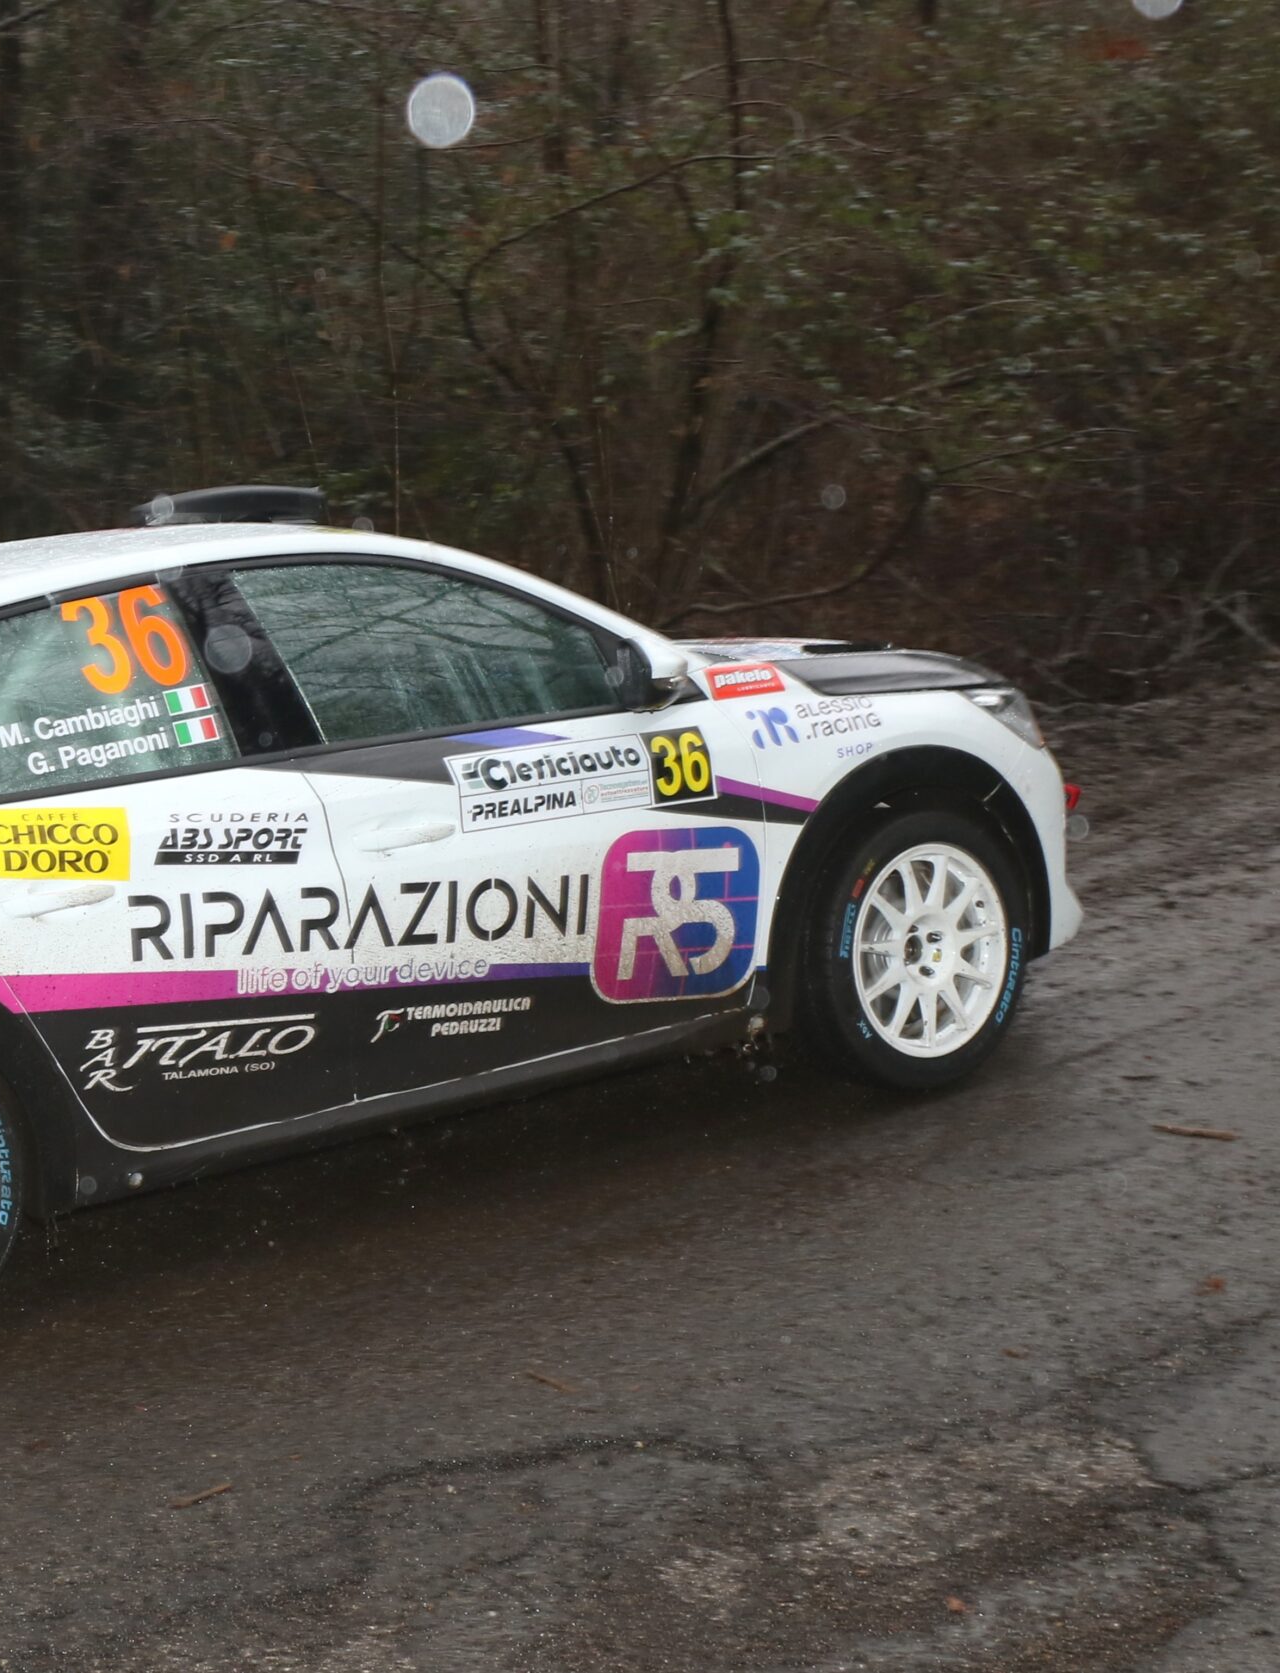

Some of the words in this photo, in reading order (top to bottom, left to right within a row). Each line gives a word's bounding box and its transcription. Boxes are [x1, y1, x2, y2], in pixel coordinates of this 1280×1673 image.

[61, 584, 187, 694] 36
[713, 668, 772, 688] pakelo
[33, 696, 161, 740] Cambiaghi
[27, 751, 56, 775] G.
[58, 727, 170, 769] Paganoni
[836, 742, 873, 758] SHOP
[650, 732, 710, 797] 36
[169, 812, 309, 823] SCUDERIA
[472, 790, 577, 822] PREALPINA
[158, 828, 213, 850] ABS
[217, 827, 309, 850] SPORT
[3, 849, 110, 873] D'ORO
[184, 853, 220, 863] SSD
[229, 853, 242, 863] A
[253, 853, 273, 863] RL
[128, 873, 589, 962] RIPARAZIONI
[237, 966, 288, 994] life
[290, 961, 325, 990] of
[325, 966, 392, 994] your
[396, 957, 490, 984] device
[406, 997, 531, 1021] TERMOIDRAULICA
[431, 1017, 502, 1037] PEDRUZZI
[80, 1029, 134, 1092] BAR
[122, 1025, 316, 1070] ITALO
[162, 1065, 239, 1081] TALAMONA
[244, 1061, 276, 1073] (SO)
